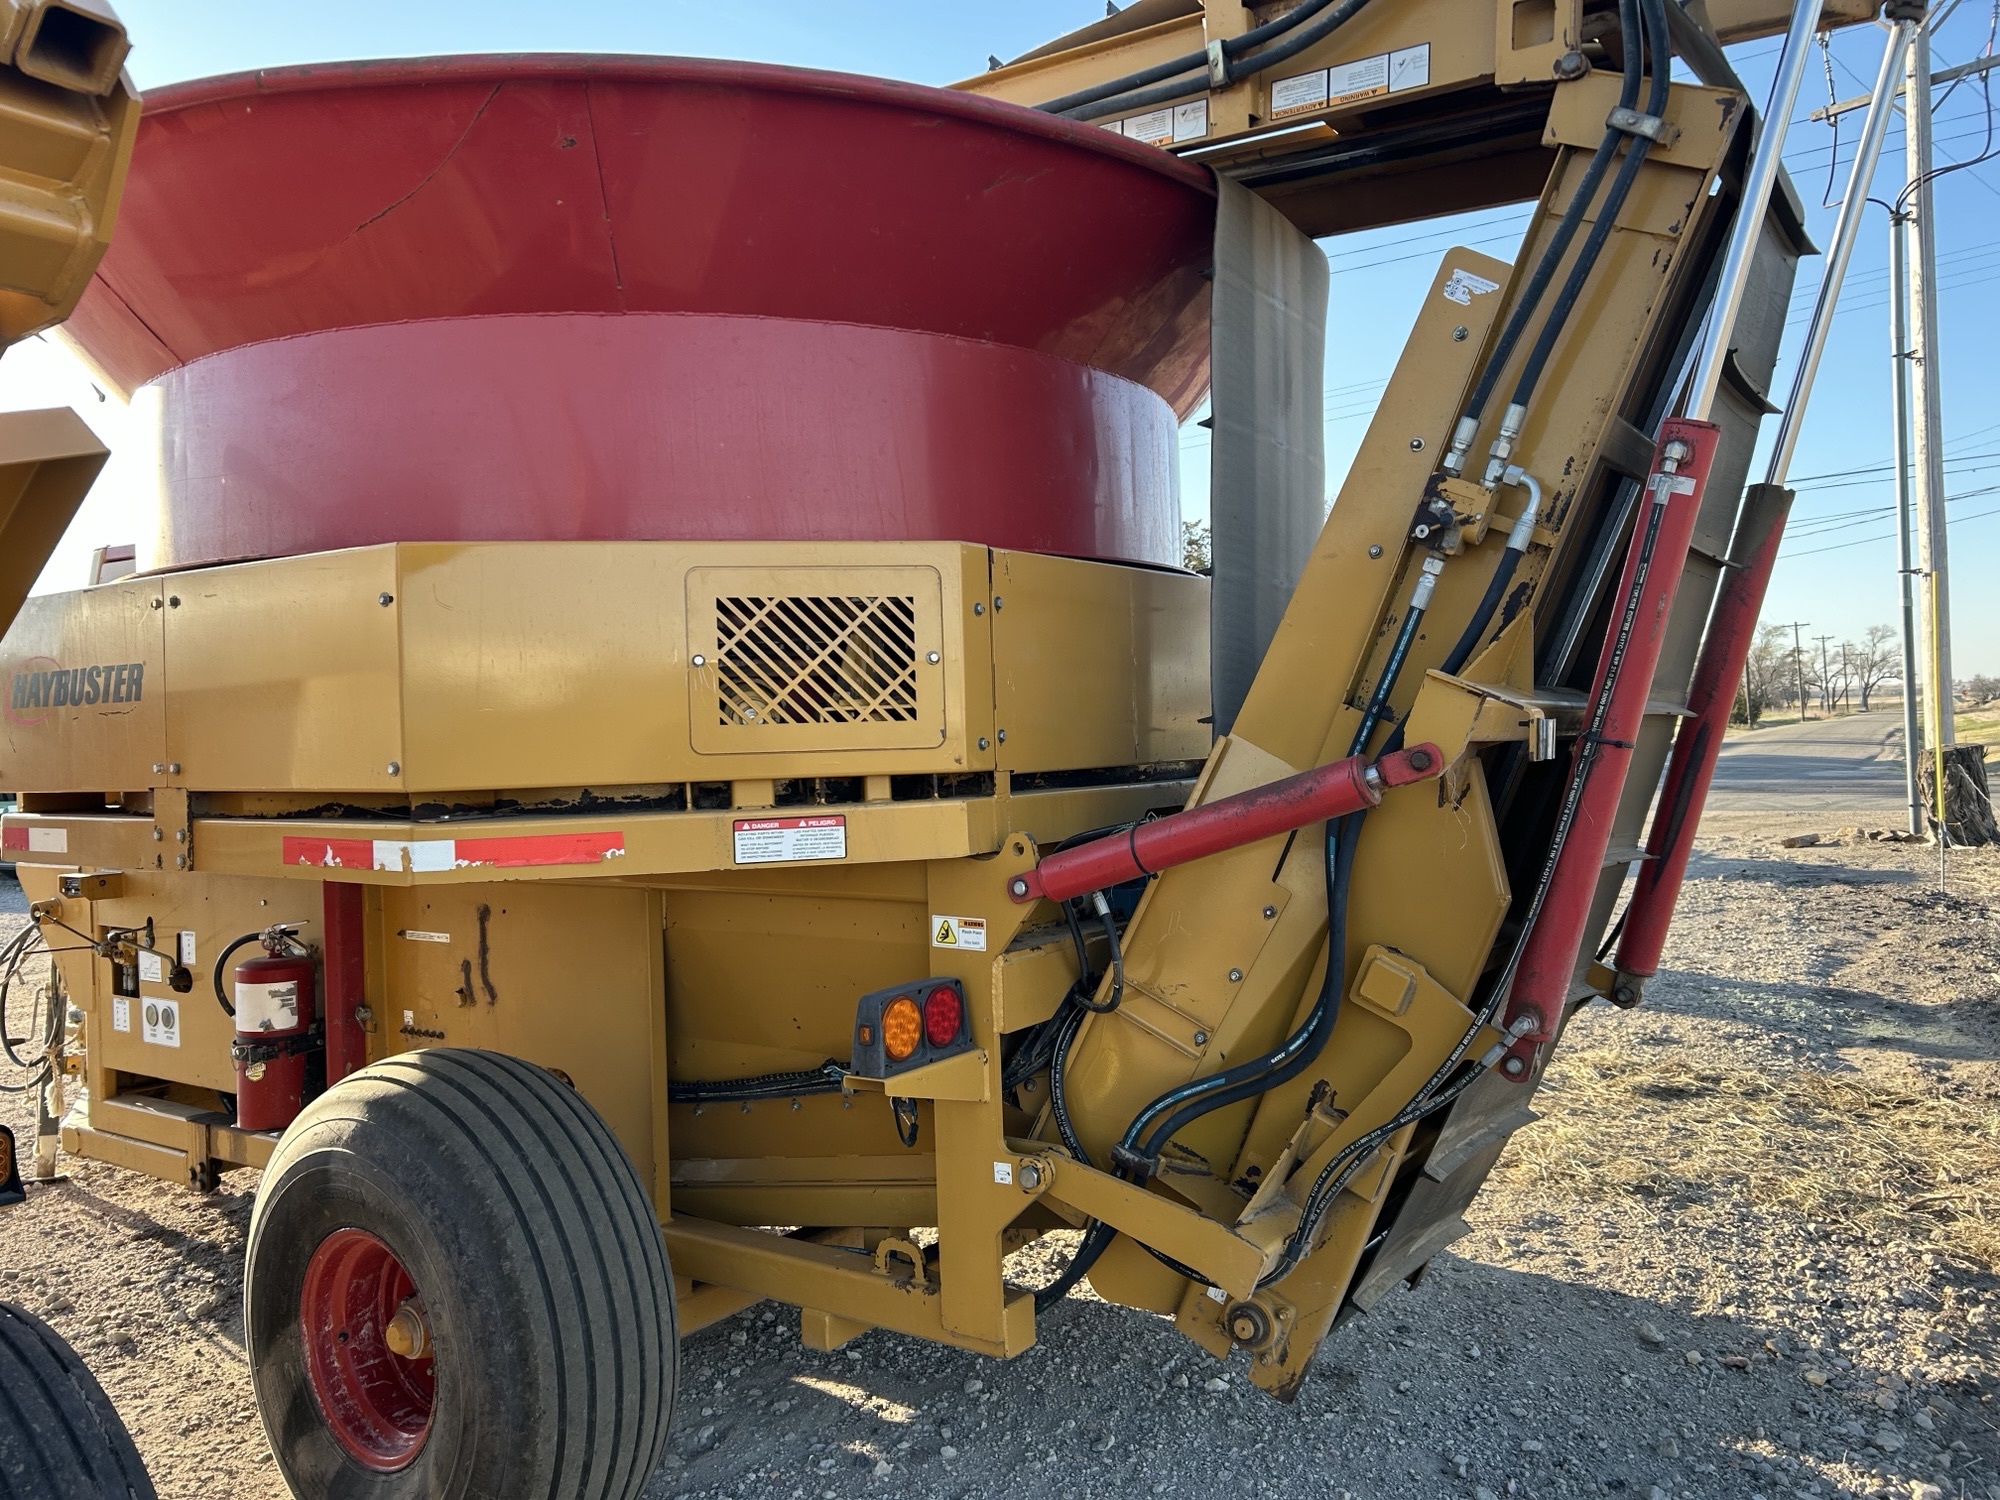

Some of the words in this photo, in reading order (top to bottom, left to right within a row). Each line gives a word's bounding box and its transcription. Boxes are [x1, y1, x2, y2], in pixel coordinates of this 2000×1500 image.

[1340, 91, 1370, 102] WARNING
[1274, 102, 1318, 118] ADVERTENCIA
[12, 663, 144, 709] HAYBUSTER
[1462, 1025, 1478, 1045] TOUGH
[1450, 1044, 1464, 1061] COVER
